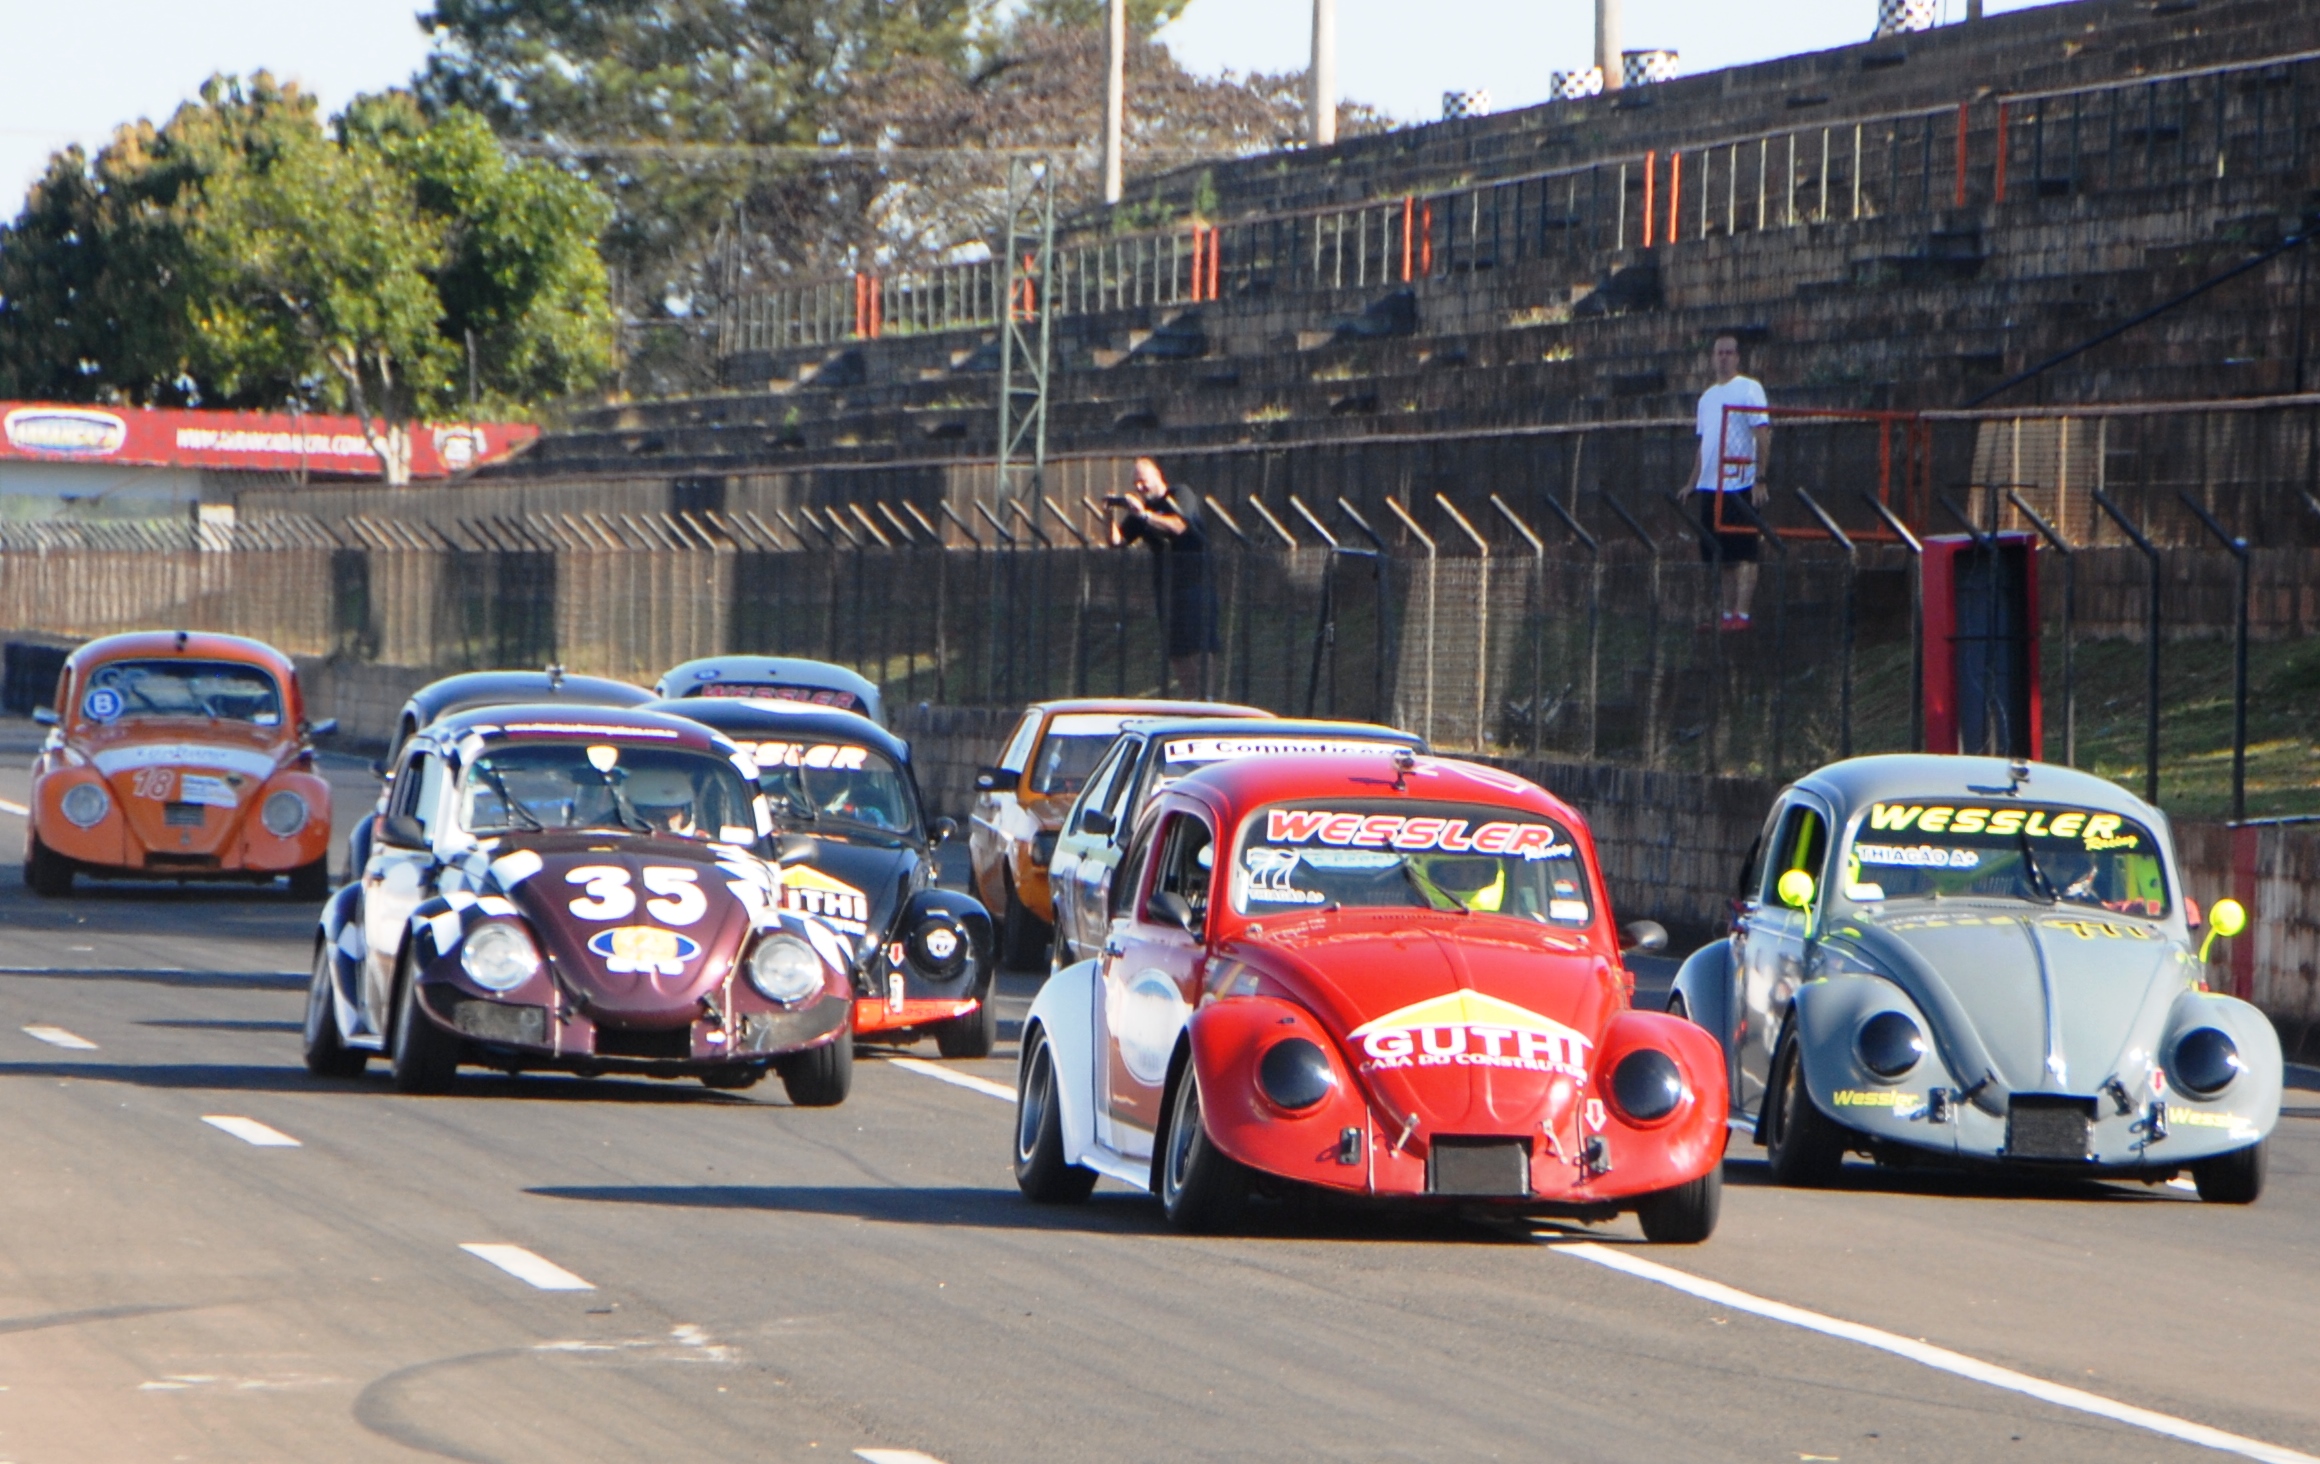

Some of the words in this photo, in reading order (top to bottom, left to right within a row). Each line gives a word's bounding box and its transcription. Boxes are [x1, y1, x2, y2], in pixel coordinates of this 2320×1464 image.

[93, 693, 113, 714] B
[1169, 742, 1200, 757] LF
[133, 767, 175, 800] 18
[1267, 809, 1554, 854] WESSLER
[1871, 803, 2122, 838] WESSLER
[565, 865, 707, 926] 35
[1363, 1025, 1584, 1069] GUTHI
[1418, 1053, 1450, 1066] DO
[1833, 1089, 1919, 1107] Wessler
